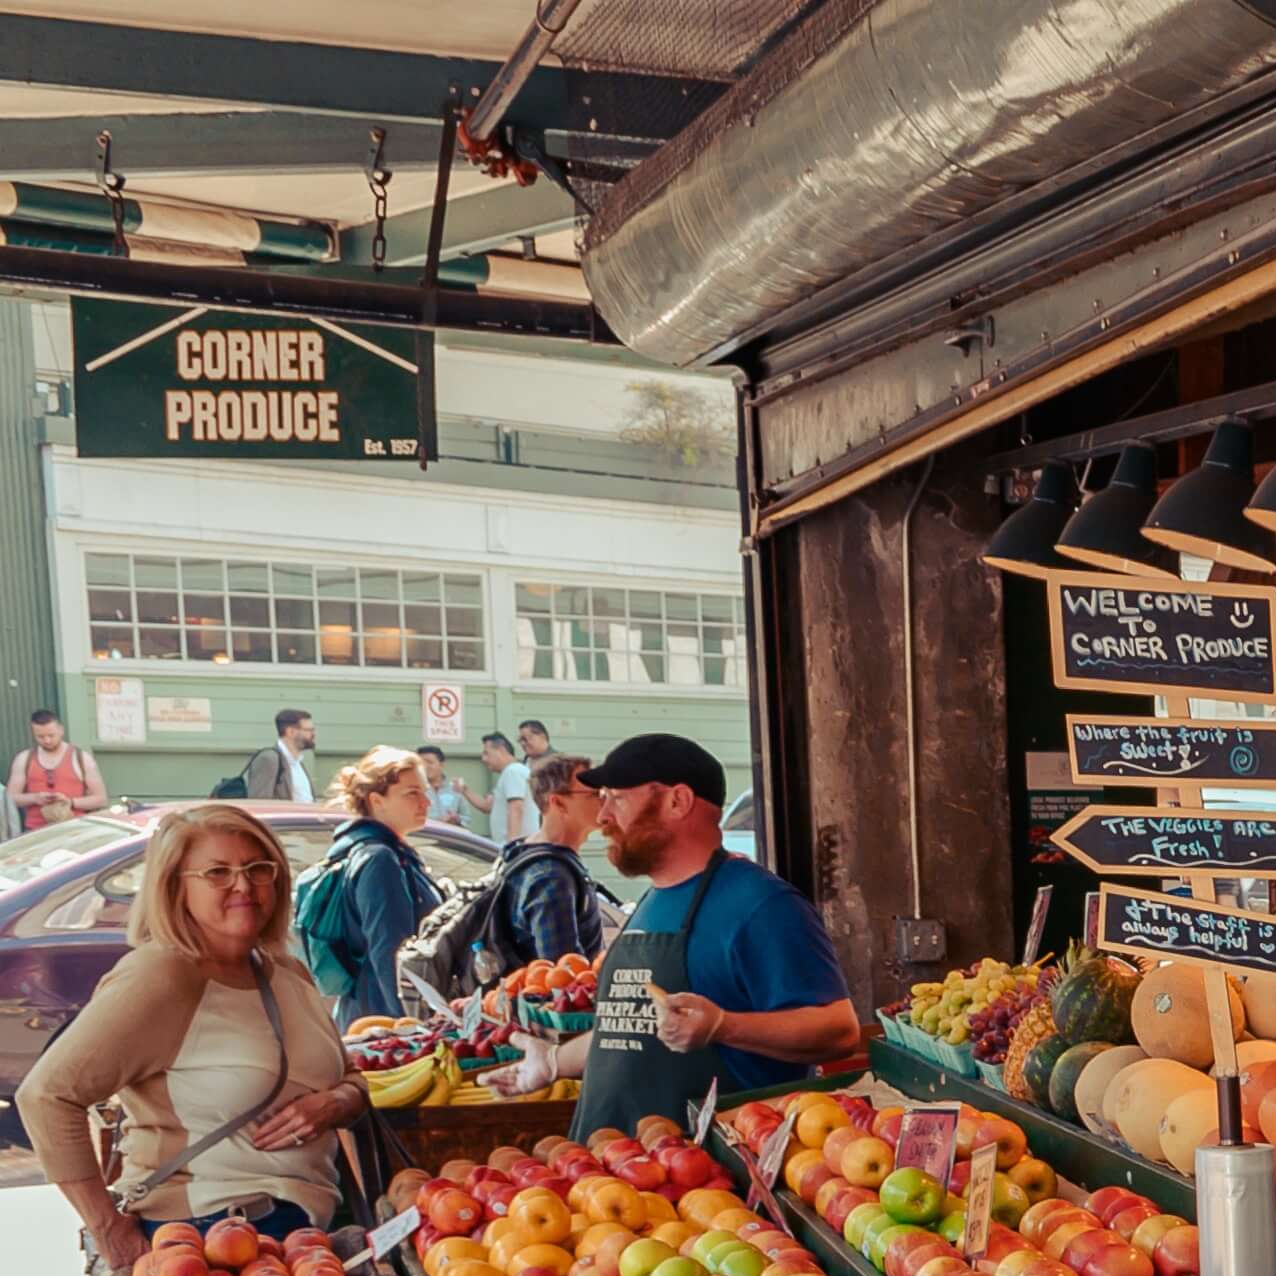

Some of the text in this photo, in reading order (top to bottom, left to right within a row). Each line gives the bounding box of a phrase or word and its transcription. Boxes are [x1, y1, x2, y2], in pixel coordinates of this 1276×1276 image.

[176, 330, 326, 382] CORNER
[164, 389, 341, 442] PRODUCE
[363, 438, 387, 456] Est.
[1175, 633, 1270, 664] PRODUCE
[1075, 725, 1254, 745] Where the fruit is
[1100, 817, 1147, 837] THE
[1189, 925, 1249, 951] helpful
[1196, 911, 1252, 934] staff
[1258, 923, 1275, 939] is
[598, 1017, 657, 1034] MARKET
